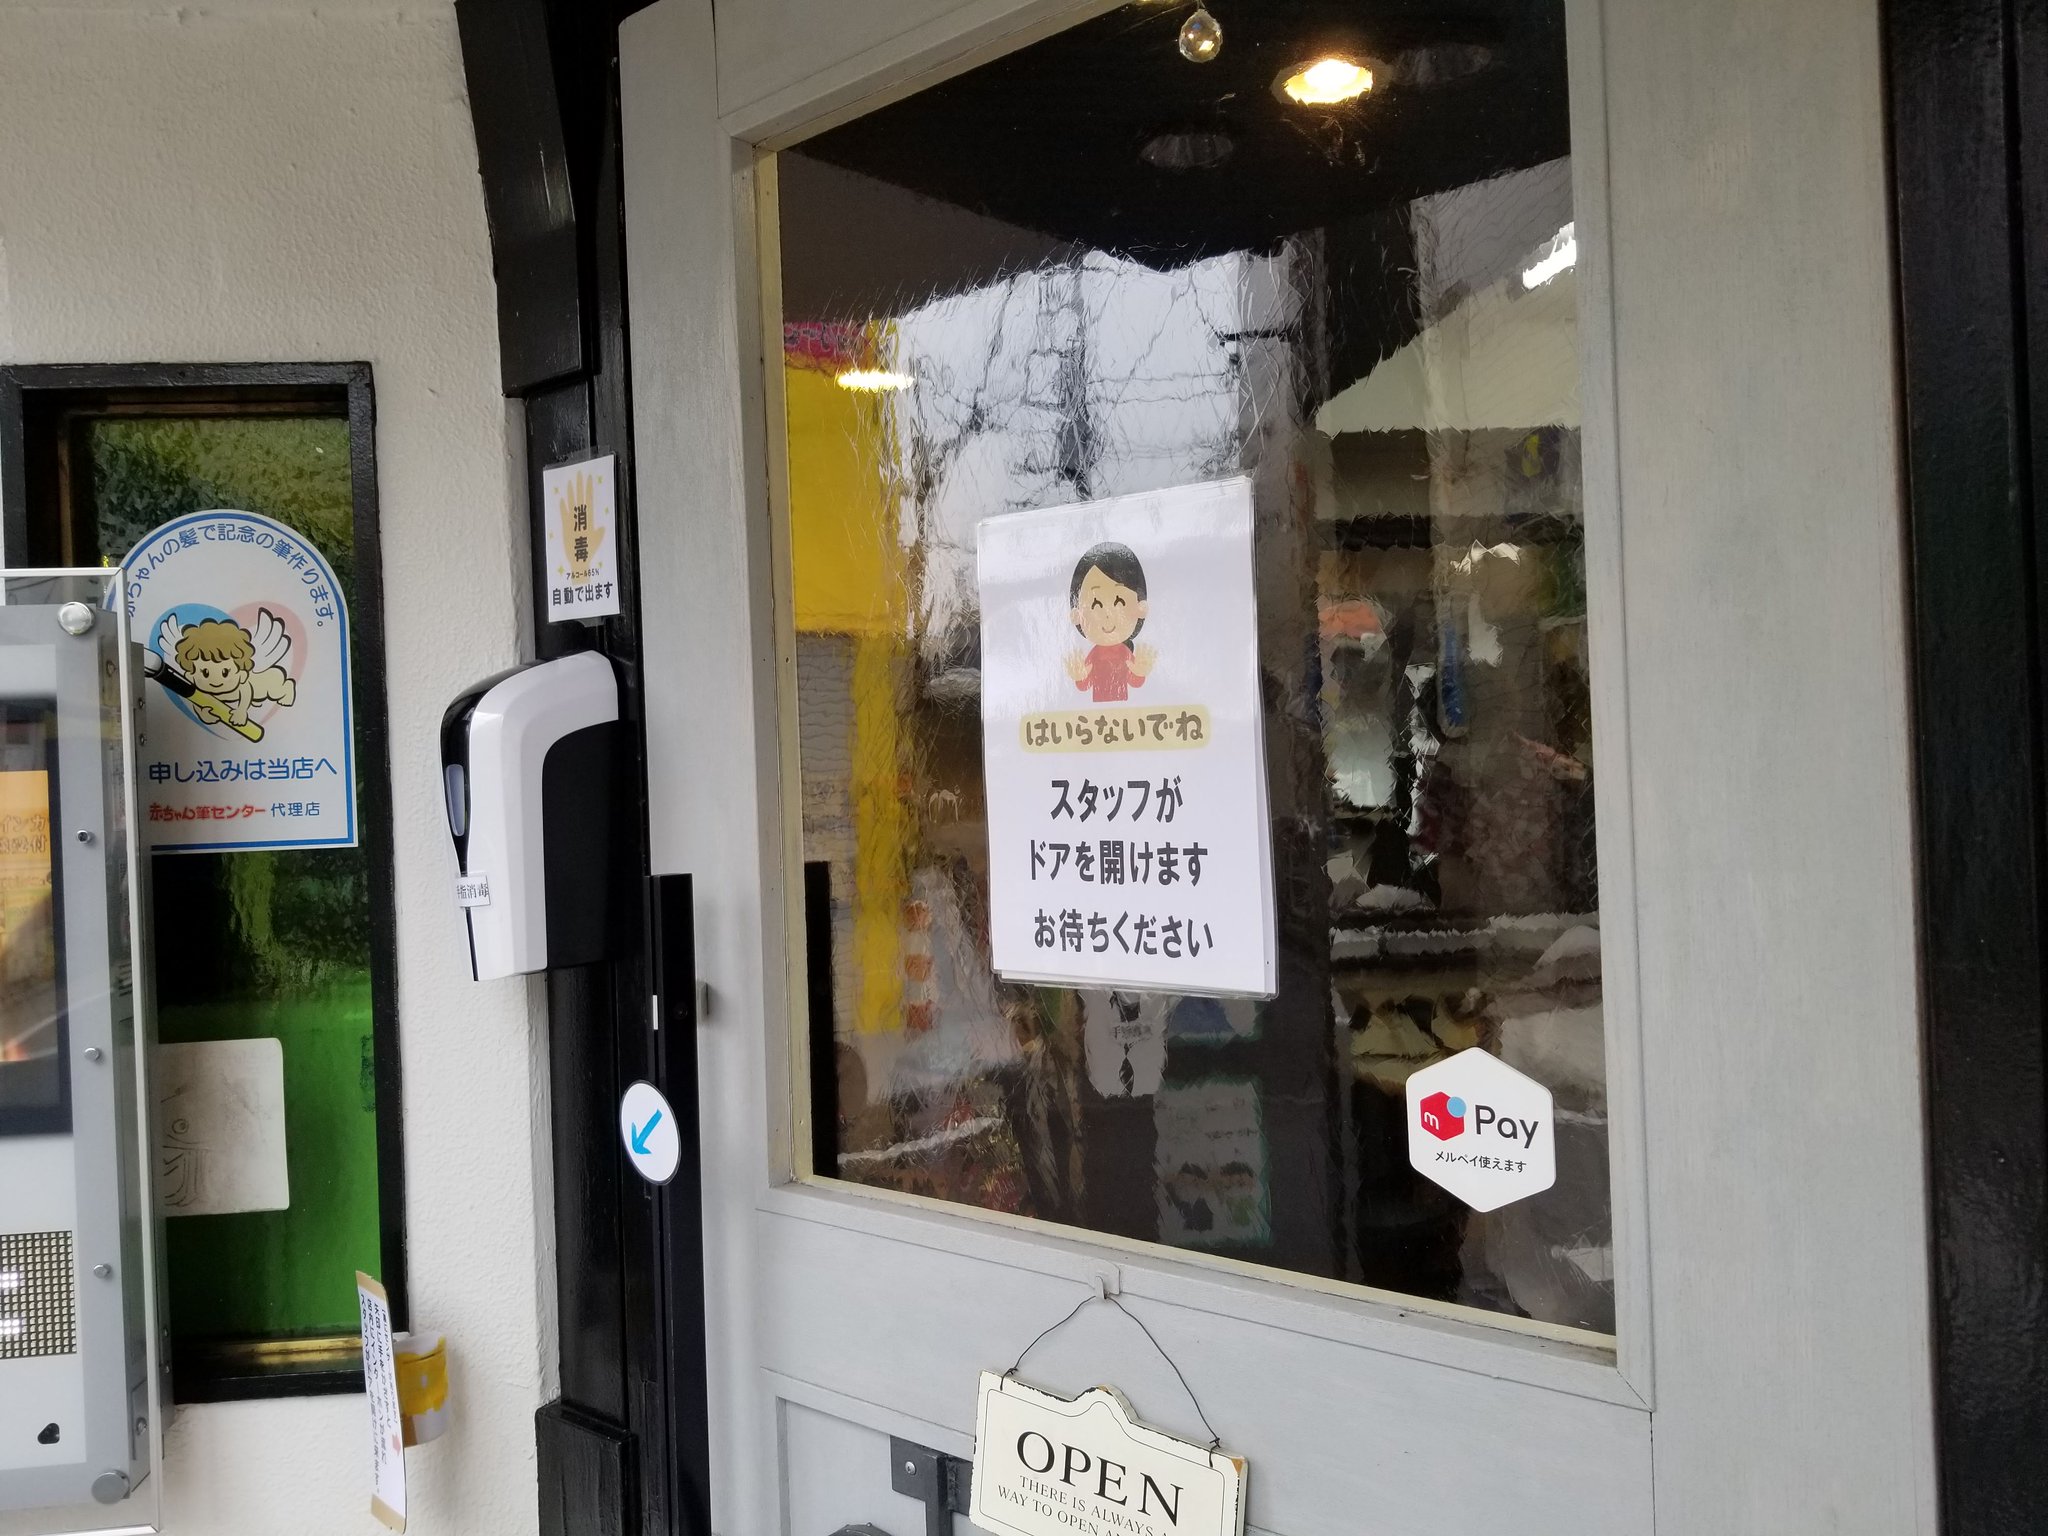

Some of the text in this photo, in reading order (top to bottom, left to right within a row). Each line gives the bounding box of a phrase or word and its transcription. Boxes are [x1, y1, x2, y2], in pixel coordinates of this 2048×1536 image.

[573, 503, 589, 563] 消毒
[552, 581, 614, 606] 自動で出ます
[1025, 711, 1204, 747] はいらないでね
[149, 756, 338, 785] 申し込みは当店へ
[148, 801, 320, 822] 赤ちゃん筆センター 代理店
[1050, 775, 1184, 823] スタッフが
[1030, 839, 1208, 887] ドアを開けます
[1033, 908, 1214, 958] お待ちください
[1475, 1104, 1539, 1149] Pay
[1435, 1151, 1527, 1173] メルペイ使えます
[1016, 1431, 1184, 1527] OPEN
[997, 1485, 1099, 1536] WAY TO OPEN
[1019, 1475, 1154, 1536] THERE IS ALWAYS
